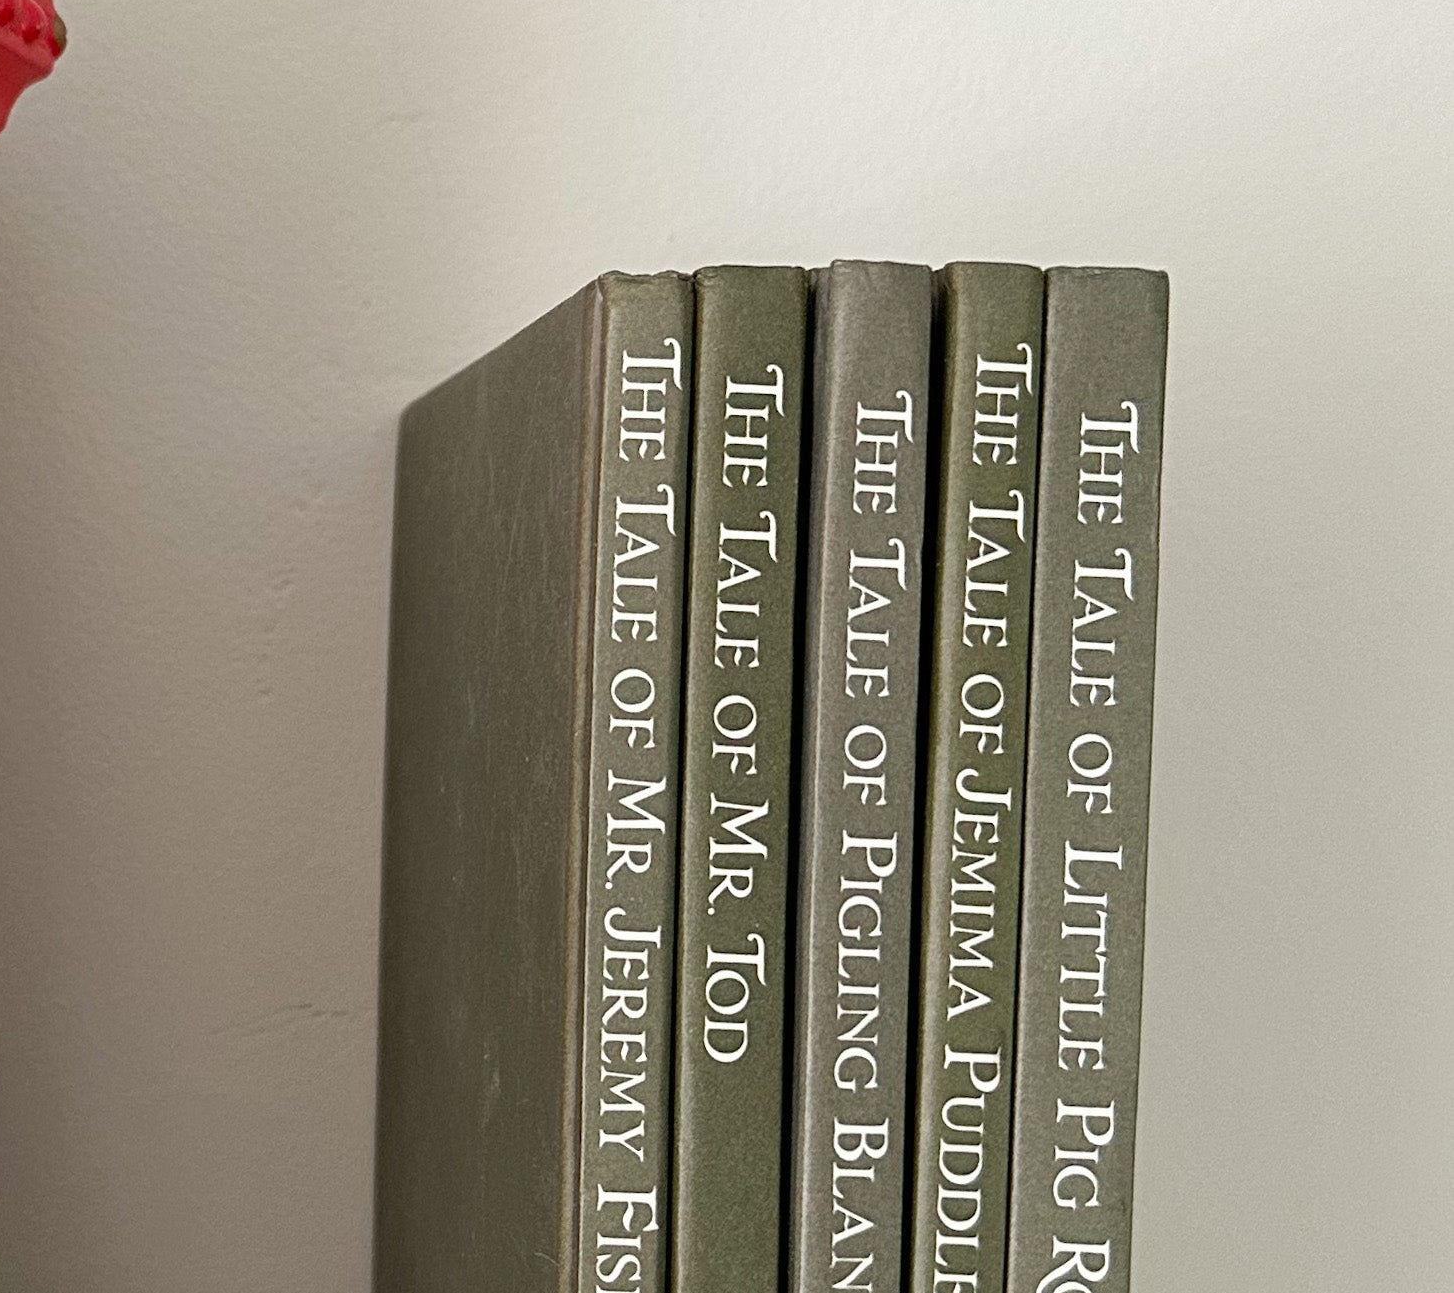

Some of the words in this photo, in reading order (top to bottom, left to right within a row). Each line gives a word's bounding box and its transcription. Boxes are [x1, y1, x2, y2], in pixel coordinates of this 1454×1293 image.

[617, 336, 683, 463] THE
[721, 363, 786, 488] THE
[852, 389, 915, 515] THE
[971, 341, 1034, 467] THE
[1076, 399, 1141, 525] THE
[610, 482, 677, 644] TALE
[713, 509, 779, 670] TALE
[844, 537, 908, 699] TALE
[961, 488, 1026, 649] TALE
[1068, 547, 1135, 708] TALE
[608, 667, 657, 750] OF
[710, 694, 758, 776] OF
[841, 723, 888, 807] OF
[958, 672, 1005, 756] OF
[603, 767, 668, 891] MR.
[1065, 732, 1114, 815] OF
[706, 791, 770, 916] MR.
[945, 767, 1013, 1022] JEMIMA
[702, 932, 767, 1064] TOD
[832, 828, 899, 1094] PIGLING
[1057, 839, 1124, 1072] LITTLE
[597, 906, 663, 1164] JEREMY
[1051, 1097, 1116, 1211] PIG
